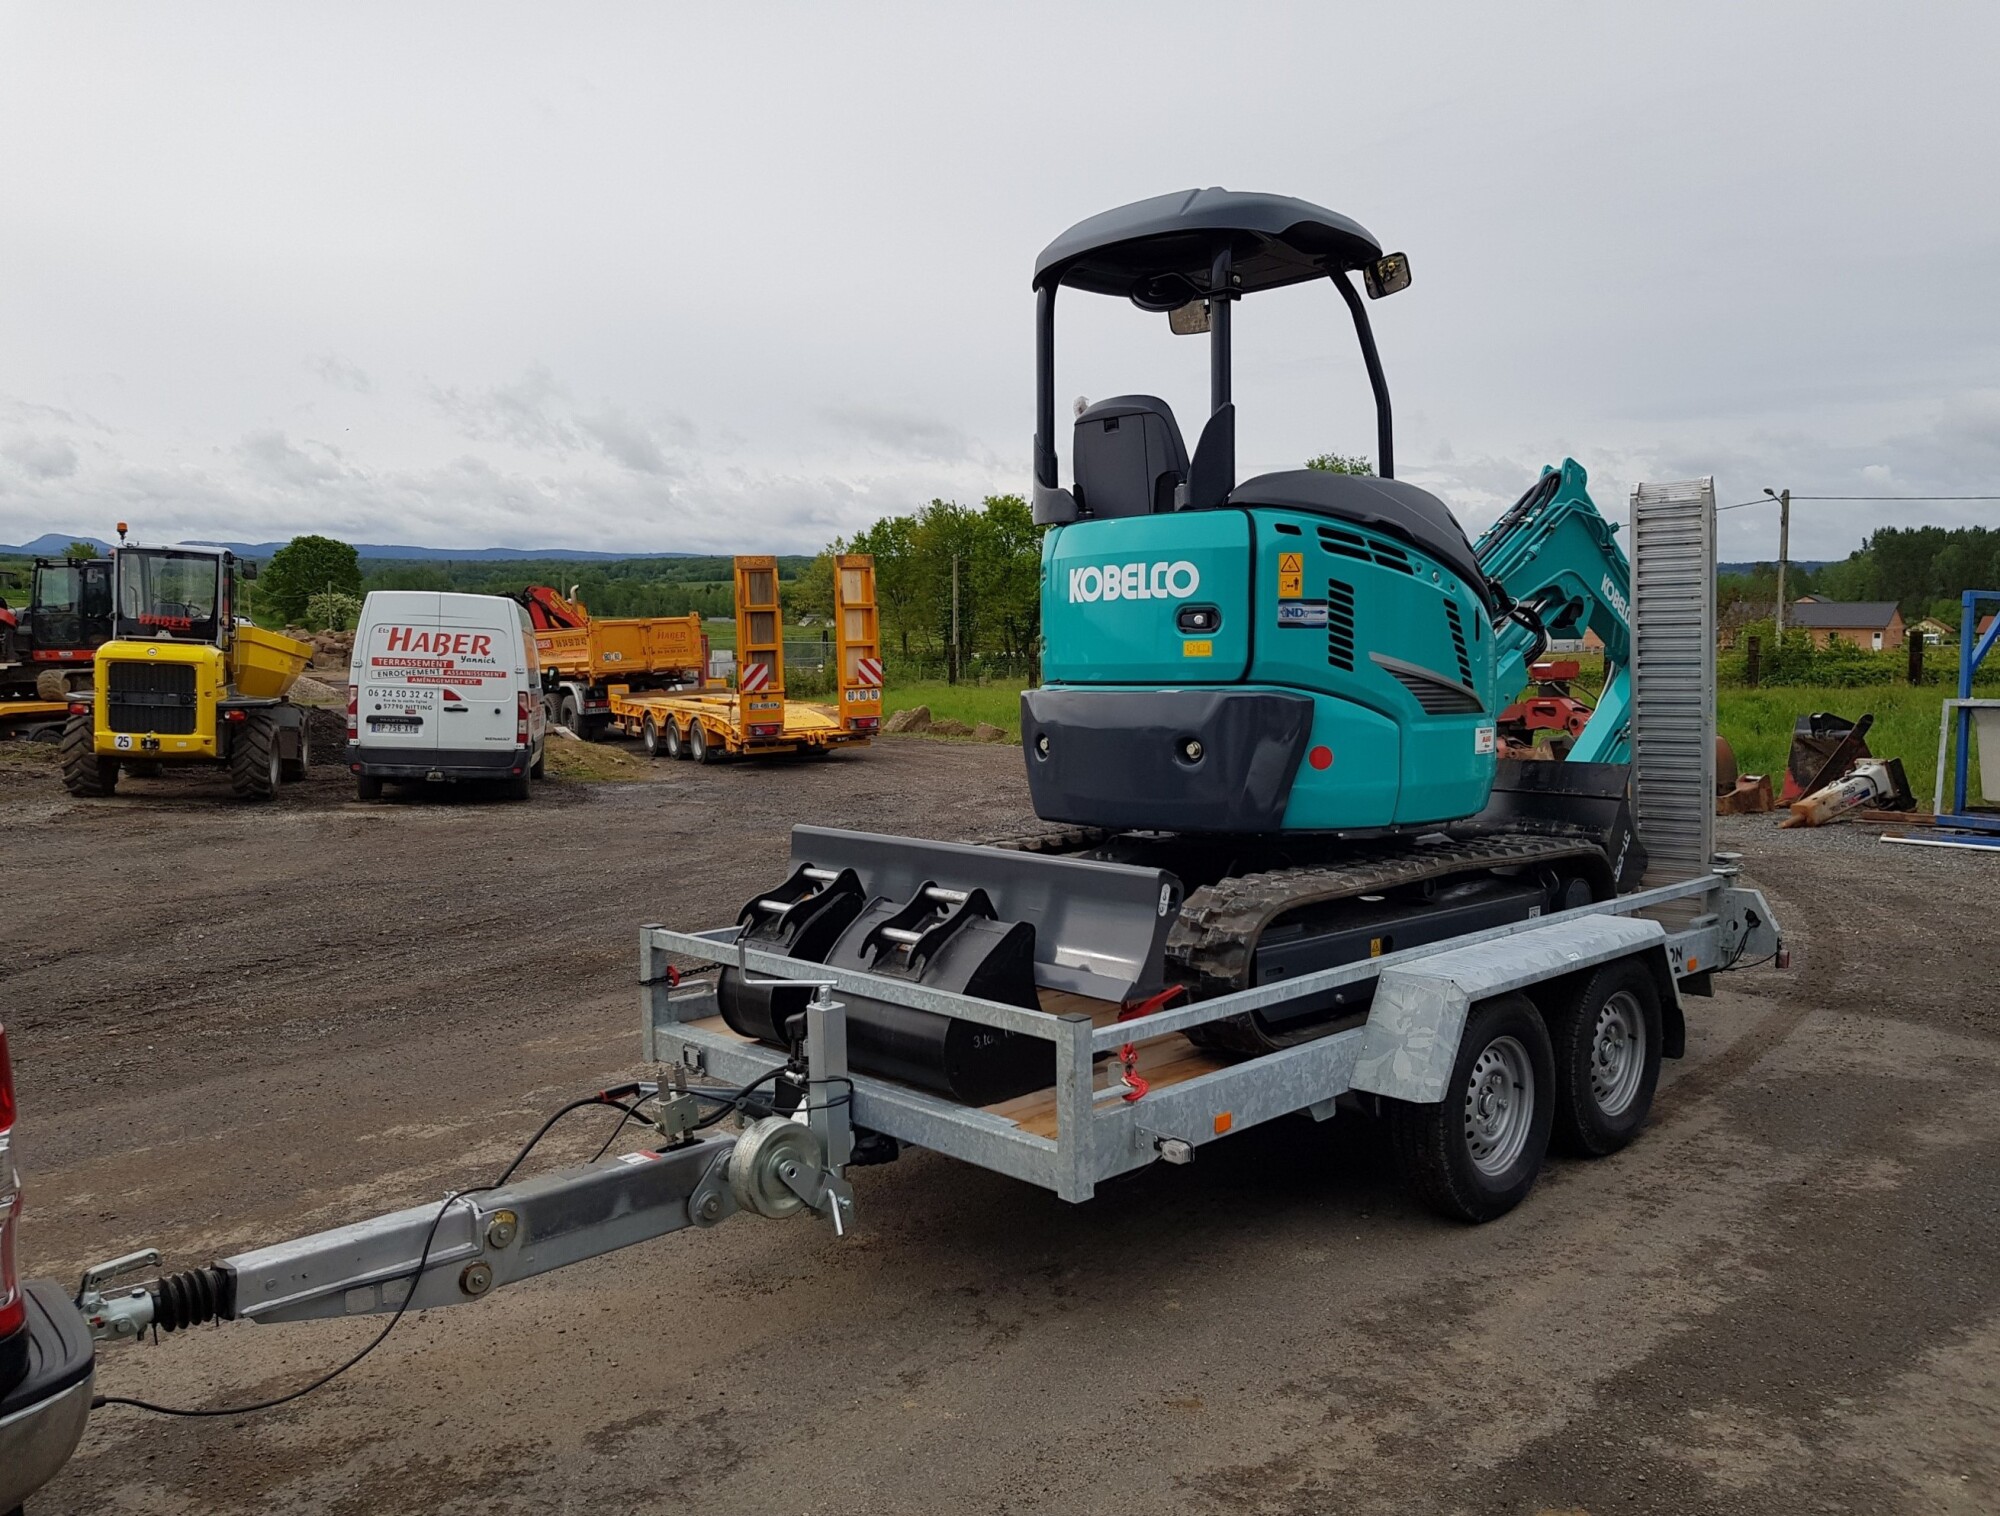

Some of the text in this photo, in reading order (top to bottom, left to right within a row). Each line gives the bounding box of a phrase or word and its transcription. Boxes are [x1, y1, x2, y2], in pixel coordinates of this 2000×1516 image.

[1069, 561, 1200, 603] KOBELCO
[1601, 573, 1630, 628] KOBELC
[387, 627, 491, 656] HABER
[378, 657, 449, 669] TERRASSEMENT
[461, 655, 496, 664] Yannick
[377, 668, 503, 678] ENROCHEMENT ASSAINISSEMENT
[368, 689, 379, 697] 06
[396, 690, 407, 698] 50
[409, 690, 420, 698] 32
[423, 691, 434, 699] 42
[117, 736, 130, 748] 25
